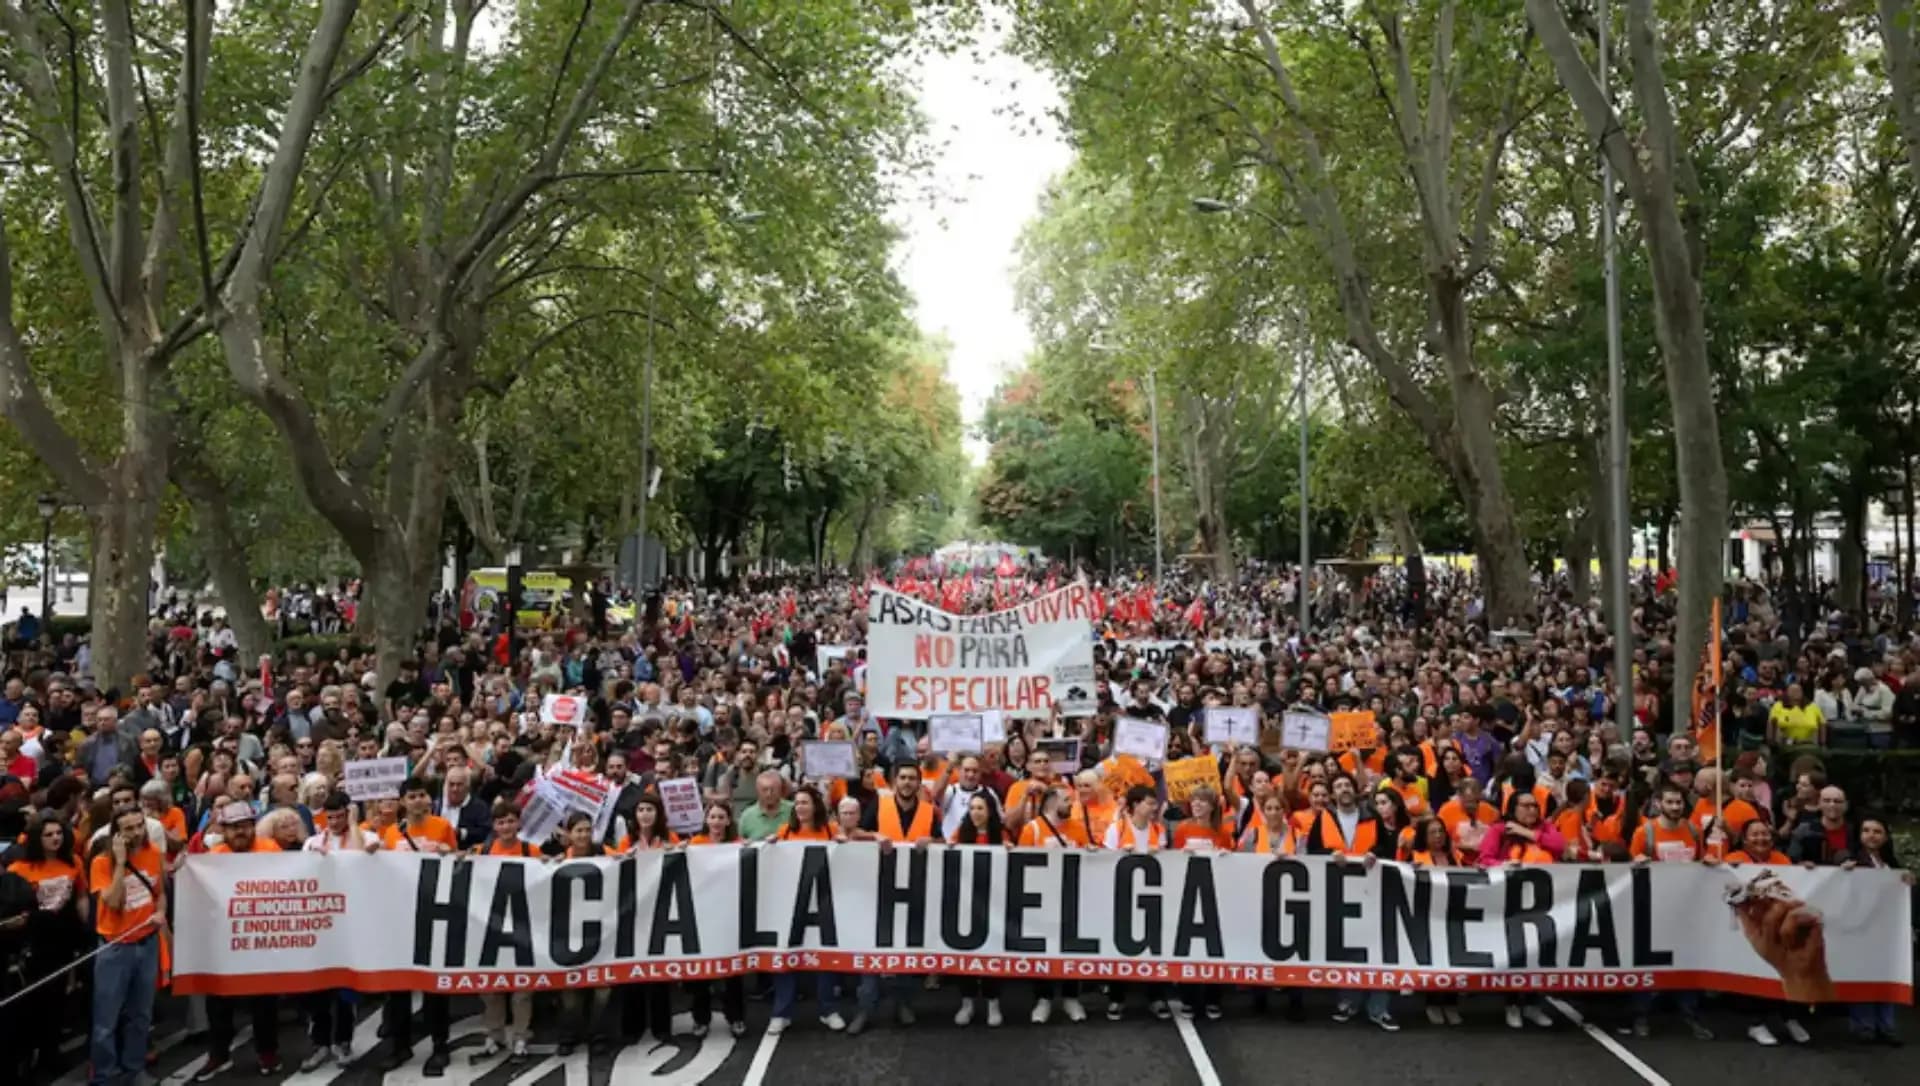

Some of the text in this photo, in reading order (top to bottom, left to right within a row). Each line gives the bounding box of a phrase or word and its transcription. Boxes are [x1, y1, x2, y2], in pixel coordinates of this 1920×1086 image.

[1022, 585, 1089, 624] VIVIR
[915, 634, 1029, 668] NO PARA
[895, 675, 1051, 711] ESPECULAR
[235, 879, 318, 894] SINDICATO
[234, 898, 343, 914] DE INQUILINAS
[413, 845, 1673, 968] HACIA LA HUELGA GENERAL
[231, 934, 317, 950] DE MADRID
[232, 916, 333, 934] E INQUILINOS
[436, 973, 551, 990] BAJADA
[566, 967, 616, 986] DEL
[629, 955, 760, 979] ALQUILER
[771, 952, 821, 969] 50%
[852, 955, 1050, 974] EXPROPIACIÓN
[1063, 961, 1170, 978] FONDOS
[1181, 965, 1276, 981] BUITRE
[1307, 969, 1468, 988] CONTRATOS
[1481, 973, 1656, 987] INDEFINIDOS
